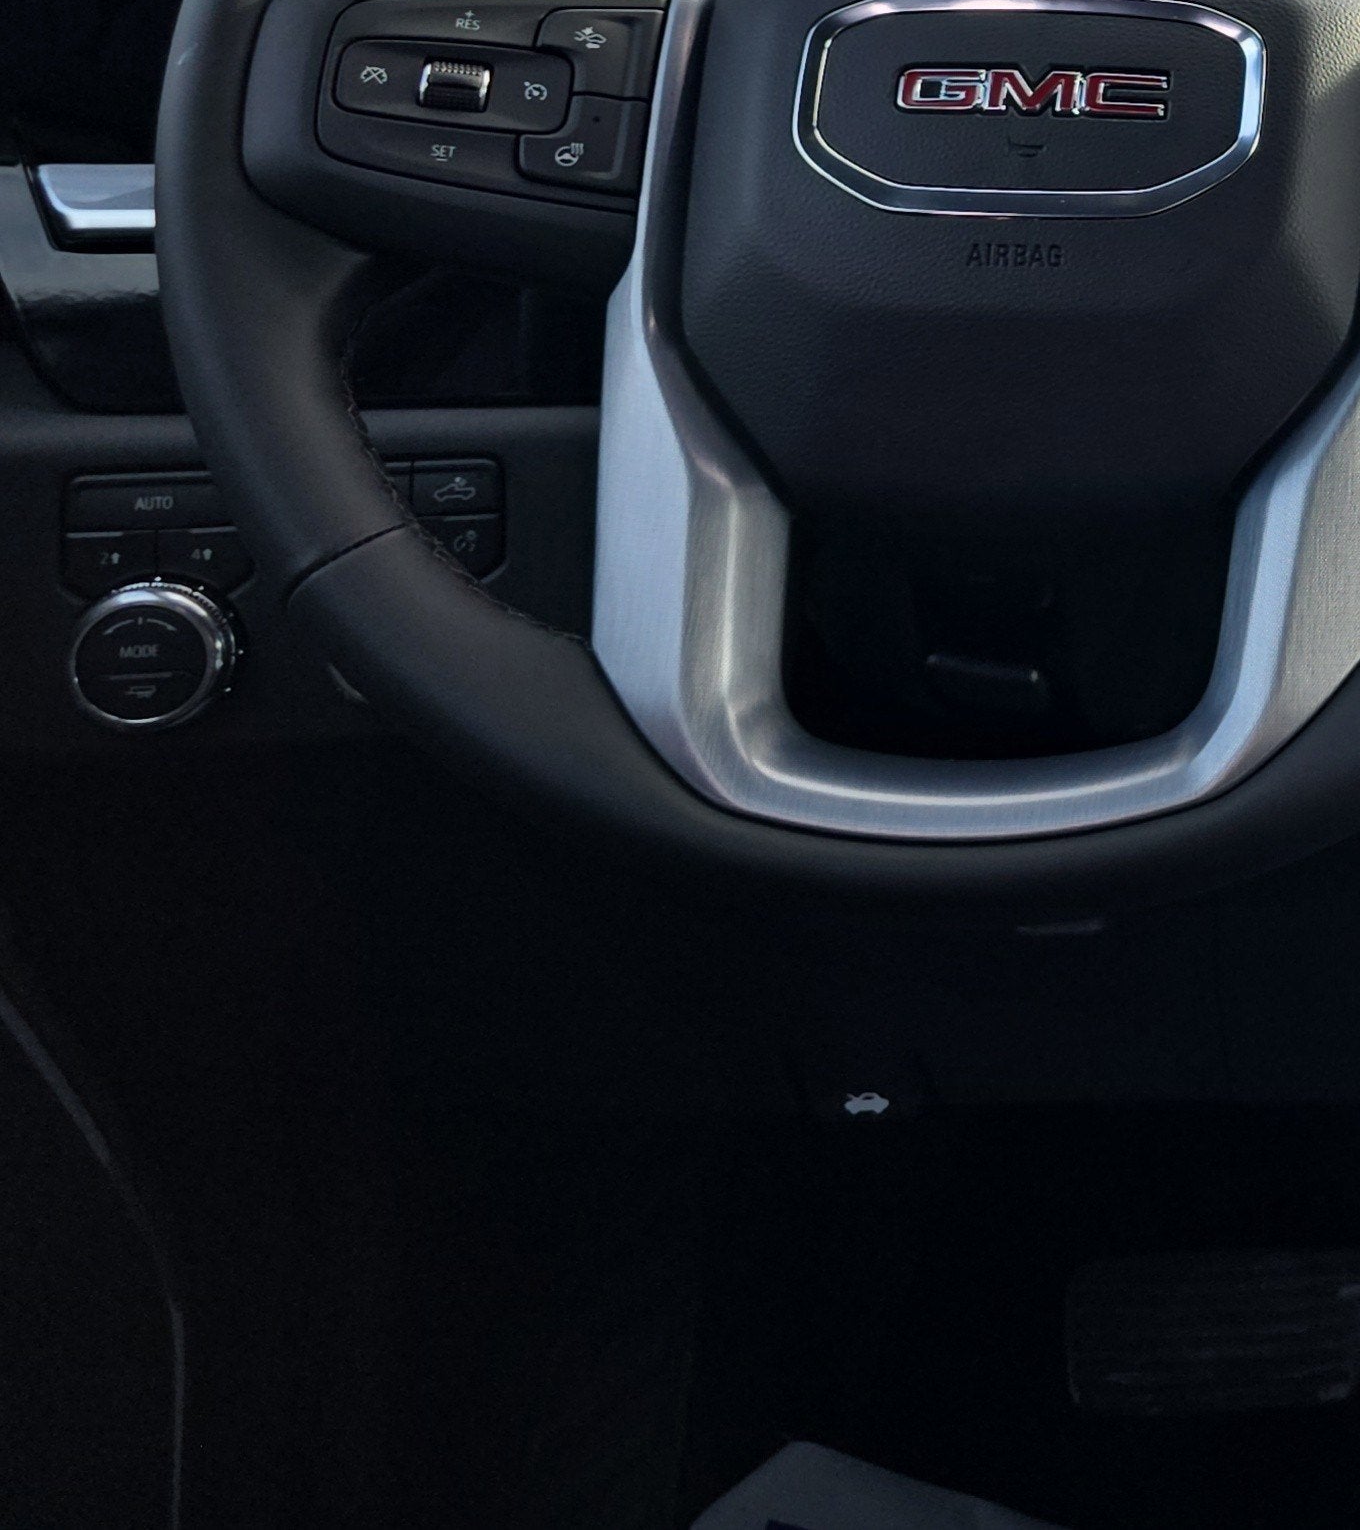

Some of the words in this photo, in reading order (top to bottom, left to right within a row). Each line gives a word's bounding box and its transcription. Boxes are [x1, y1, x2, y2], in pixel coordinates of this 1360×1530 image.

[897, 68, 1170, 117] GMC
[430, 144, 456, 159] SET
[966, 242, 1064, 269] AIRBAG
[134, 496, 174, 511] AUTO
[119, 644, 159, 658] MODE
